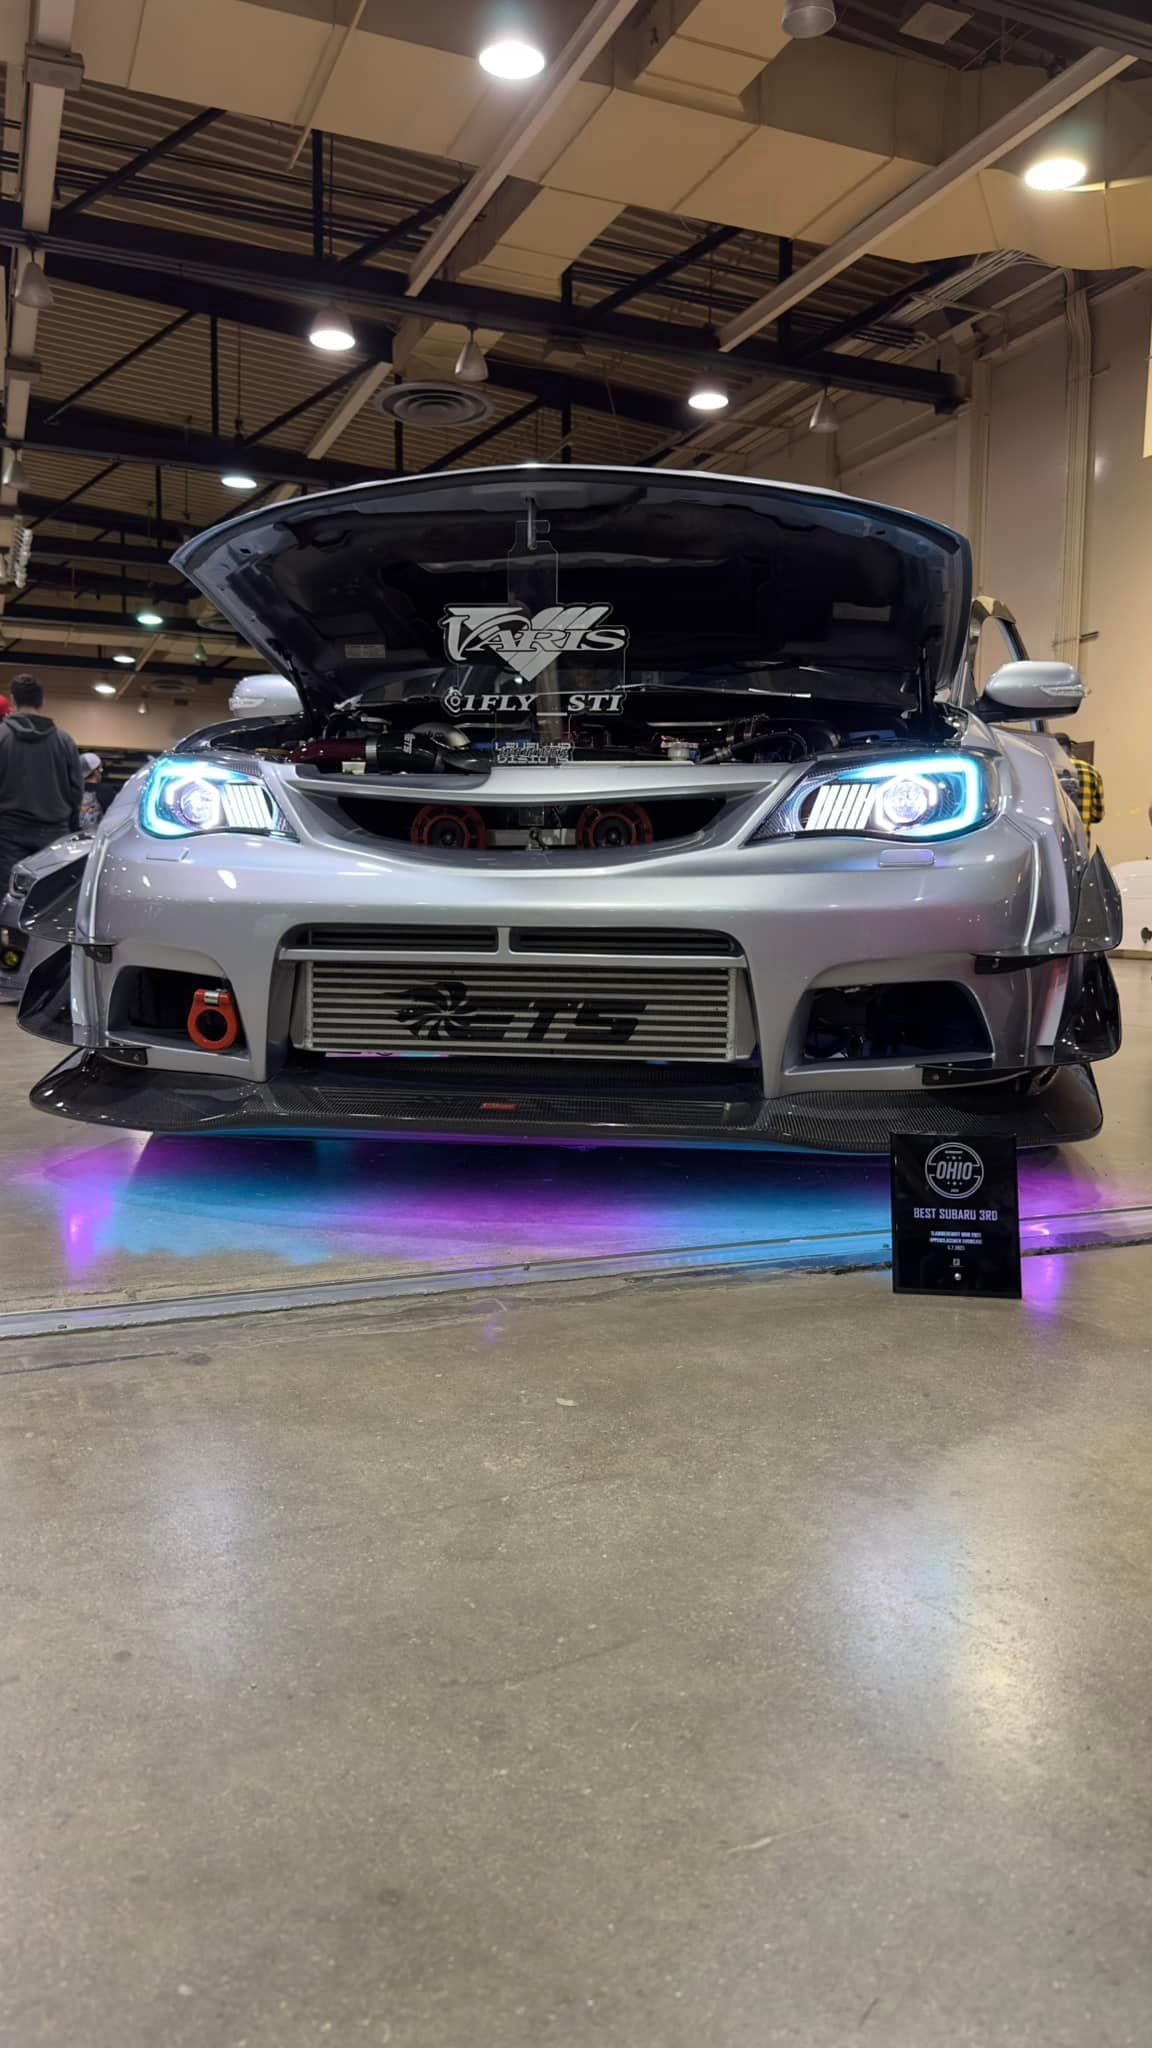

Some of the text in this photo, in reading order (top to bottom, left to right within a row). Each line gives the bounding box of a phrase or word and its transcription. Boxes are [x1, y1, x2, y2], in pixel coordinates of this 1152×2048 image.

[442, 612, 626, 662] VARIS
[935, 1160, 973, 1180] OHIO
[913, 1207, 998, 1222] BEST SUBARU 3RD
